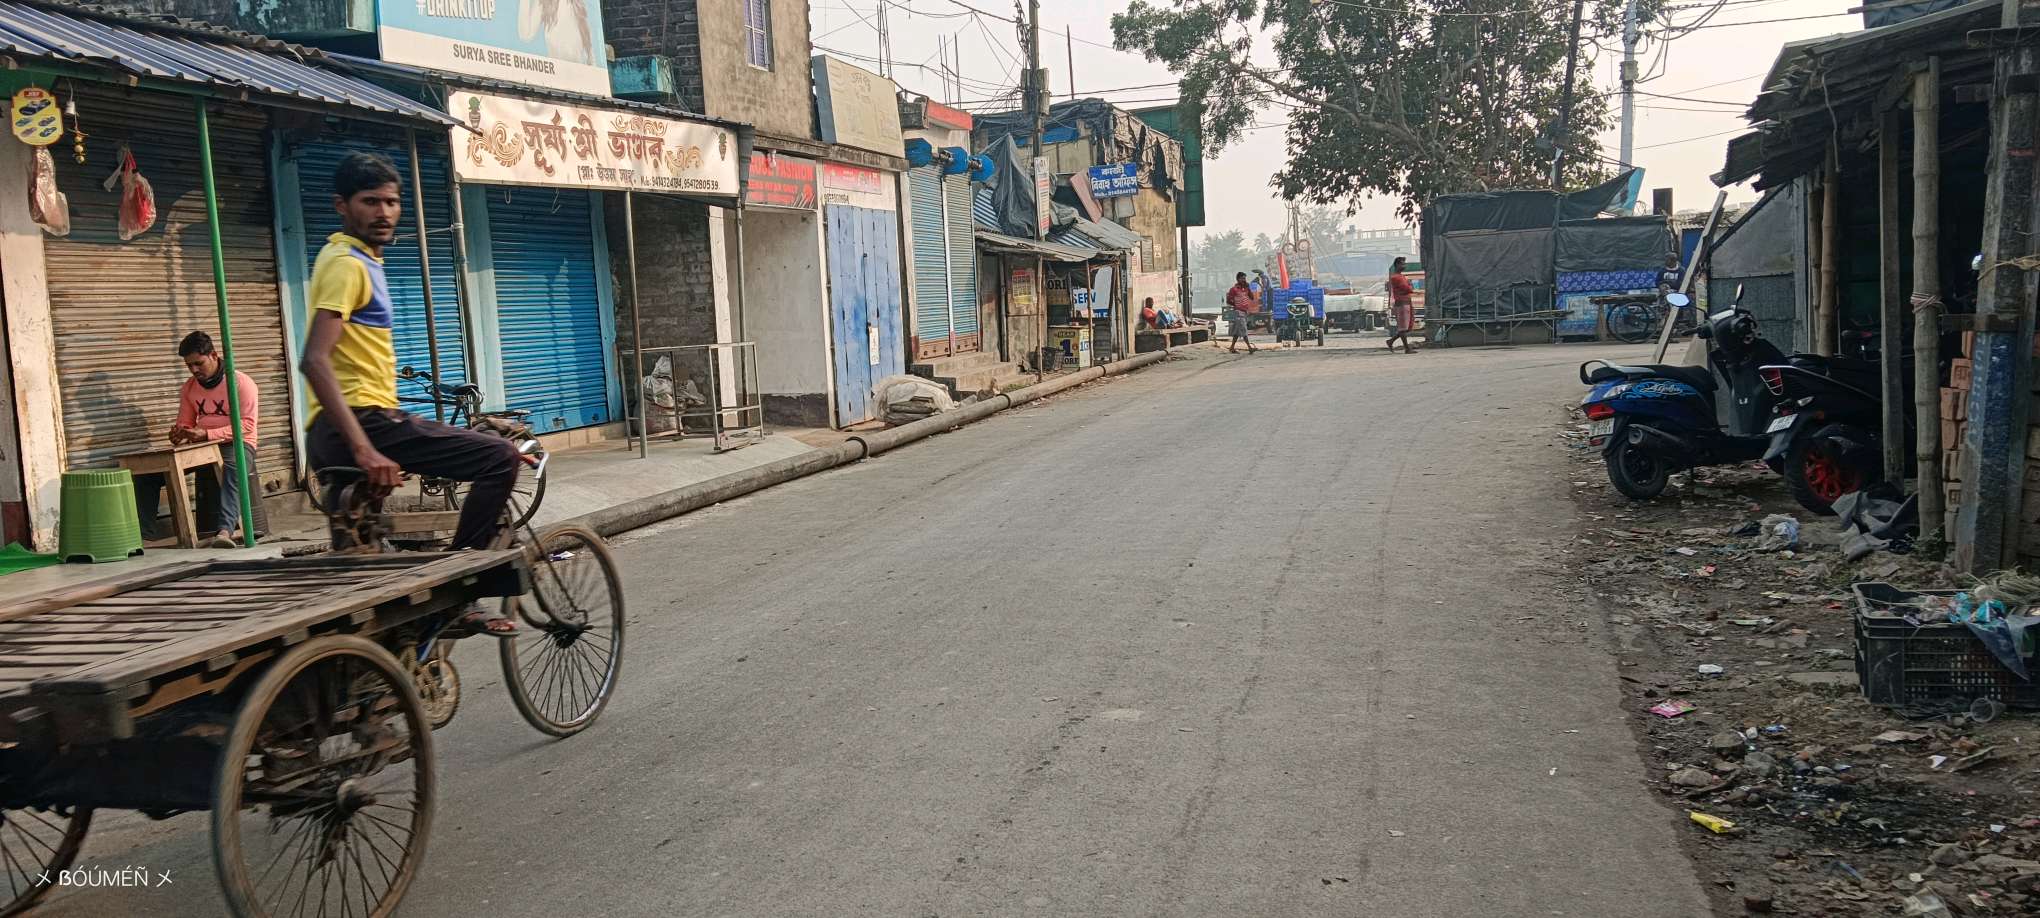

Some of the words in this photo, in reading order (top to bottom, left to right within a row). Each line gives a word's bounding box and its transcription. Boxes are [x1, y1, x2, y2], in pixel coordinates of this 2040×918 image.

[453, 43, 485, 63] SURYA
[487, 50, 511, 67] SREE
[513, 55, 555, 75] BHANDER
